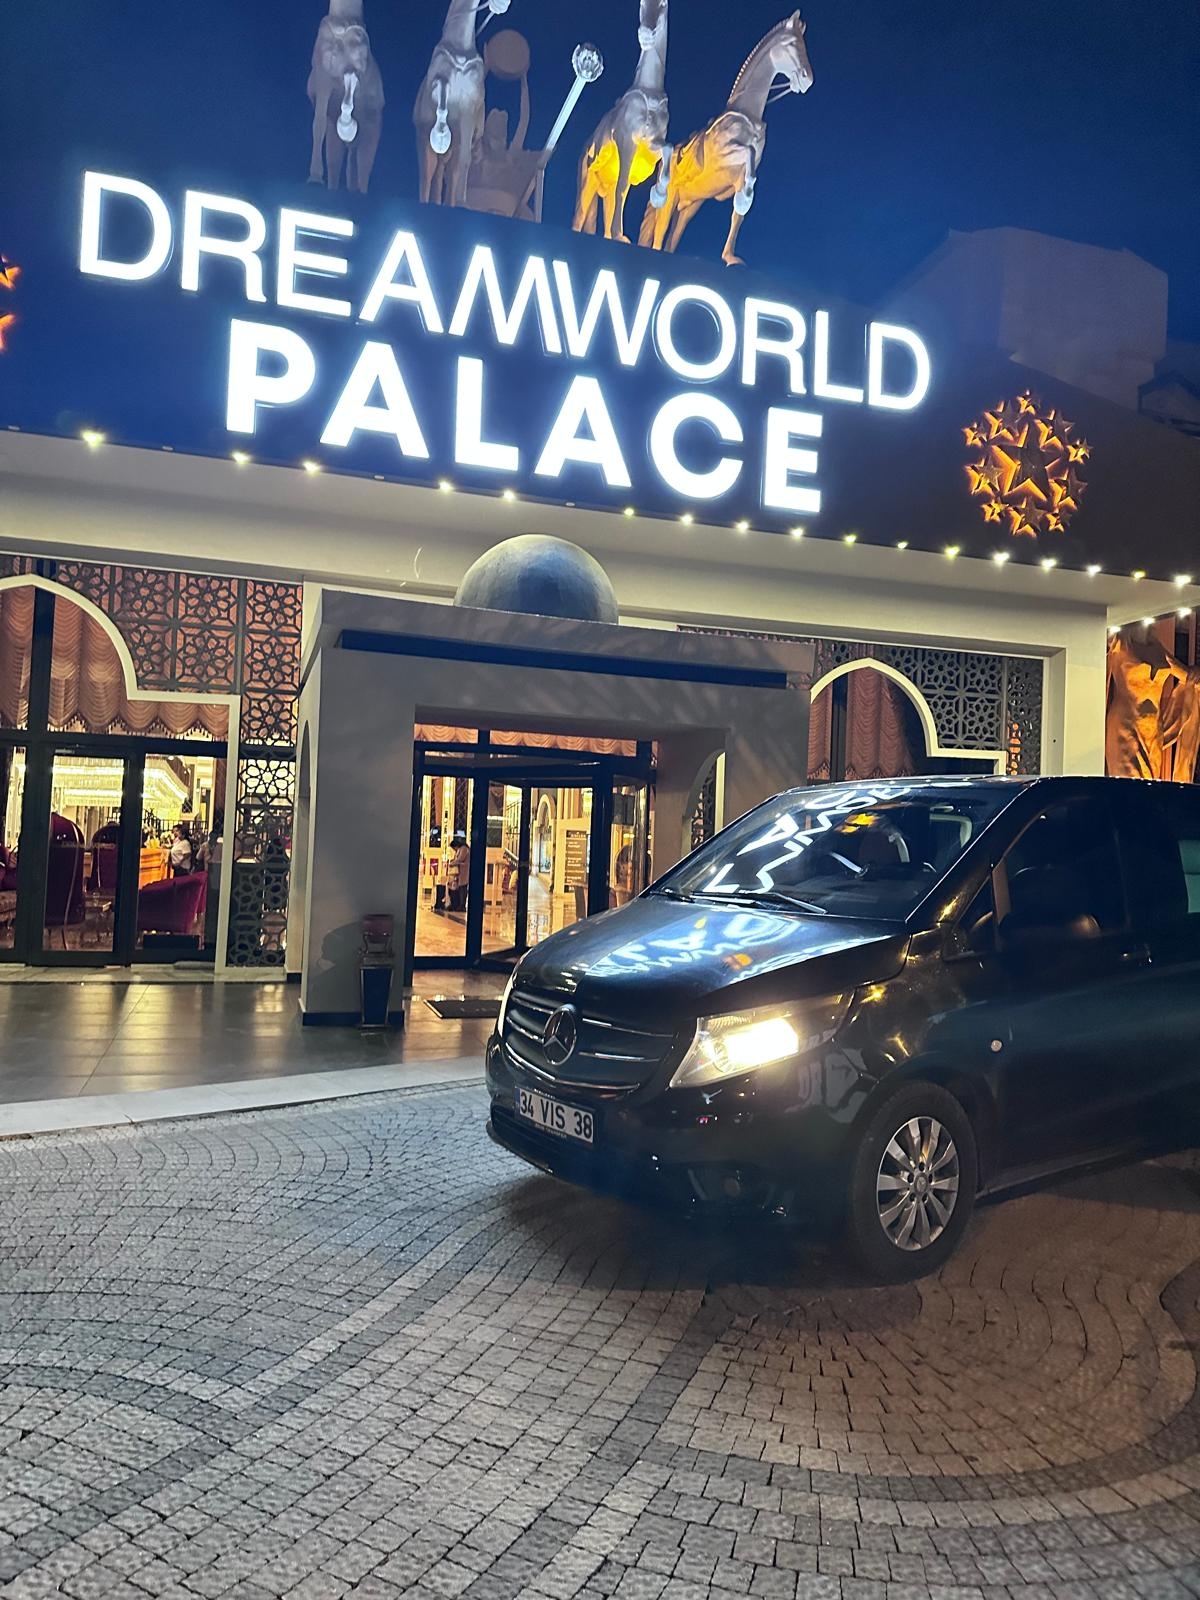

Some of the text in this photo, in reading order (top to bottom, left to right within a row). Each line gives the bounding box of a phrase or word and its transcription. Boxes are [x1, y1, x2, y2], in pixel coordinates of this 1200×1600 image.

[79, 171, 931, 411] DREAMWORLD
[226, 318, 823, 513] PALACE
[520, 1091, 534, 1117] 34
[540, 1098, 566, 1129] VIS
[573, 1111, 593, 1139] 38
